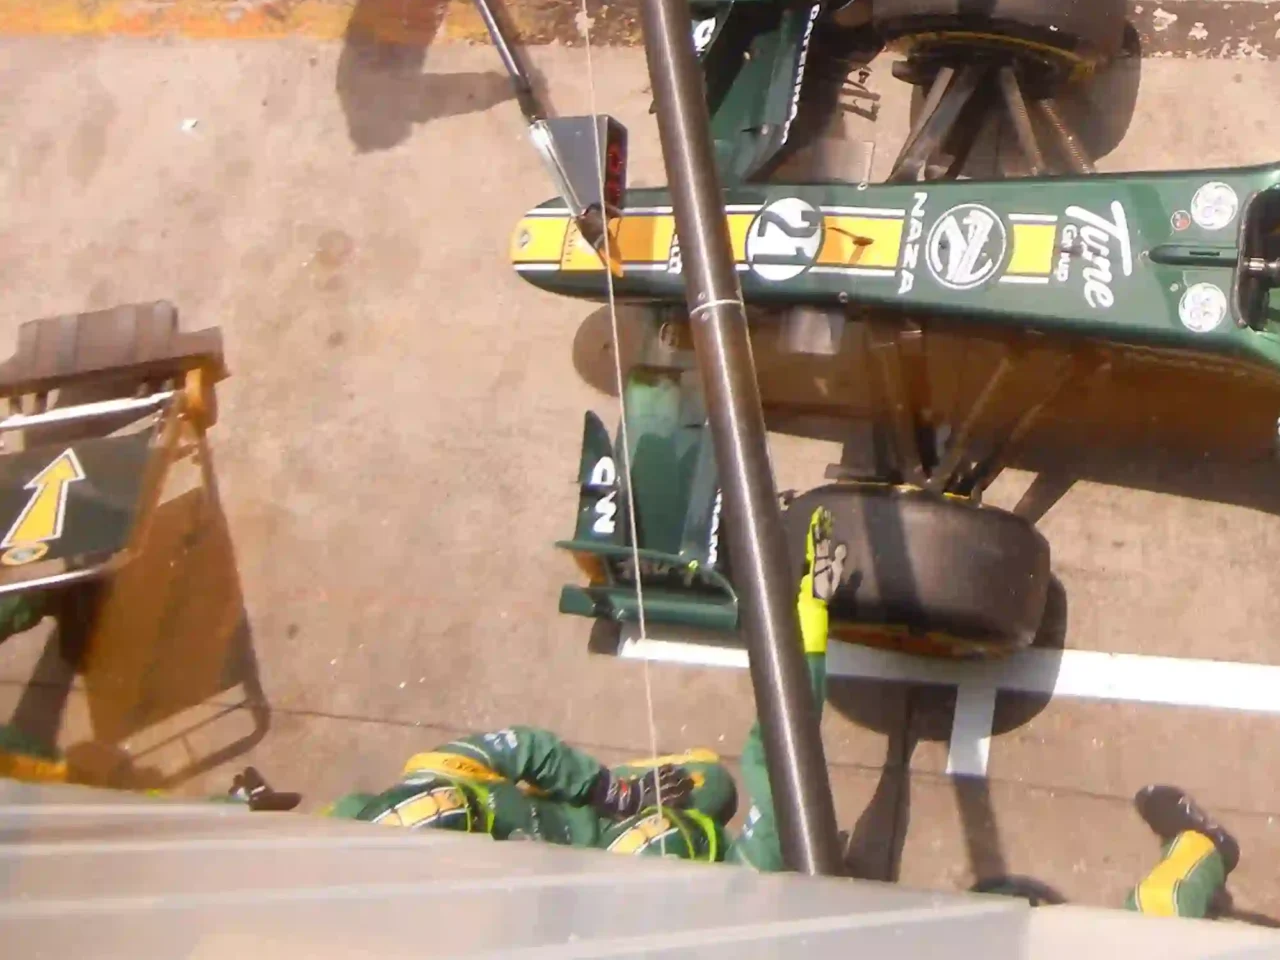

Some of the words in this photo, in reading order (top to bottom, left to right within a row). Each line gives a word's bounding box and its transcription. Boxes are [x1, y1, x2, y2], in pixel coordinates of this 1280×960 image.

[752, 209, 823, 267] 21
[898, 192, 928, 295] NAZA
[1064, 200, 1134, 309] Tune
